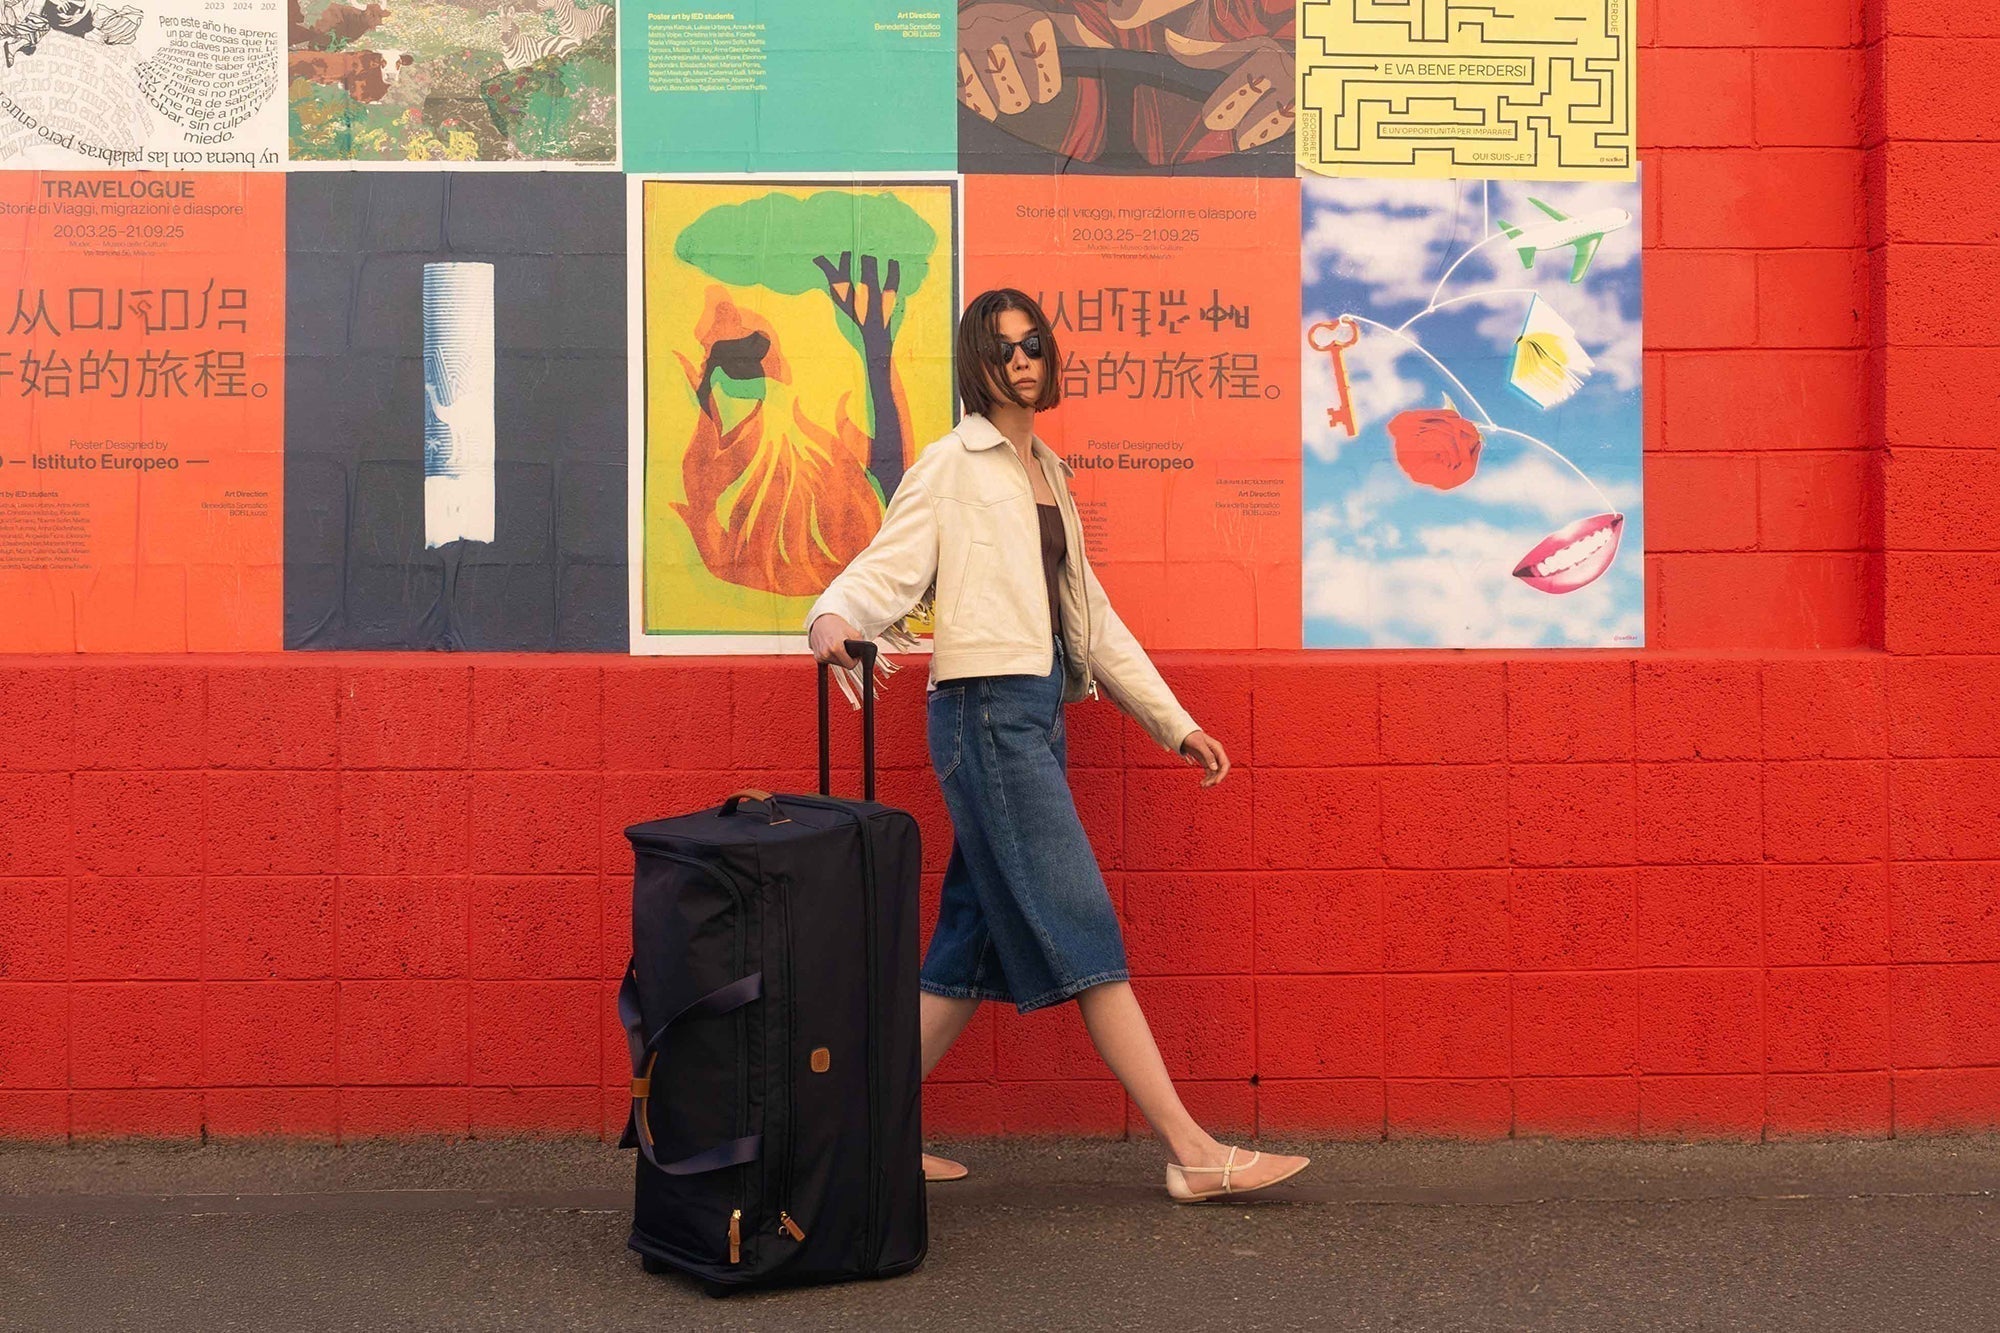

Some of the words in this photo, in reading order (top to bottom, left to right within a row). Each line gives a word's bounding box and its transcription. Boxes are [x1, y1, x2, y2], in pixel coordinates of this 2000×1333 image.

[204, 2, 225, 10] 2023
[233, 2, 253, 10] 2024
[682, 13, 690, 21] by
[159, 16, 179, 27] Pero
[181, 16, 200, 28] este
[202, 20, 221, 32] año
[224, 23, 237, 34] he
[166, 29, 177, 38] un
[179, 30, 192, 39] par
[196, 30, 208, 40] de
[210, 34, 239, 45] cosas
[242, 39, 262, 47] que
[170, 39, 188, 47] sido
[190, 41, 220, 52] claves
[223, 46, 245, 54] para
[157, 46, 195, 58] primera
[197, 51, 209, 60] es
[211, 53, 230, 62] que
[233, 54, 245, 62] es
[185, 68, 215, 79] saber
[218, 71, 239, 80] que
[1396, 64, 1415, 75] VA
[1419, 64, 1455, 76] BENE
[1459, 64, 1526, 77] PERDERSI
[213, 80, 234, 88] con
[163, 83, 202, 106] forma
[205, 100, 221, 108] de
[211, 90, 226, 98] no
[159, 93, 183, 110] me
[218, 110, 226, 118] a
[189, 120, 209, 130] sin
[213, 110, 251, 130] culpa
[183, 131, 234, 144] miedo.
[148, 151, 169, 167] las
[174, 152, 202, 163] con
[207, 152, 255, 168] buena
[1310, 154, 1316, 164] ED
[1473, 153, 1492, 161] QUI
[1494, 153, 1523, 161] SUIS-JE
[1526, 153, 1532, 161] ?
[43, 180, 195, 198] TRAVELOGUE
[38, 202, 50, 215] di
[53, 202, 98, 217] Viaggi,
[101, 202, 170, 216] migrazioni
[172, 205, 180, 214] e
[183, 202, 244, 216] diaspore
[1016, 205, 1055, 218] Storie
[70, 440, 103, 450] Poster
[106, 440, 153, 451] Designed
[156, 440, 168, 450] by
[1088, 440, 1120, 450] Poster
[1123, 440, 1170, 451] Designed
[1172, 440, 1184, 451] by
[32, 454, 96, 469] Istituto
[101, 454, 179, 472] Europeo
[1060, 454, 1114, 469] tituto
[1118, 454, 1194, 472] Europeo
